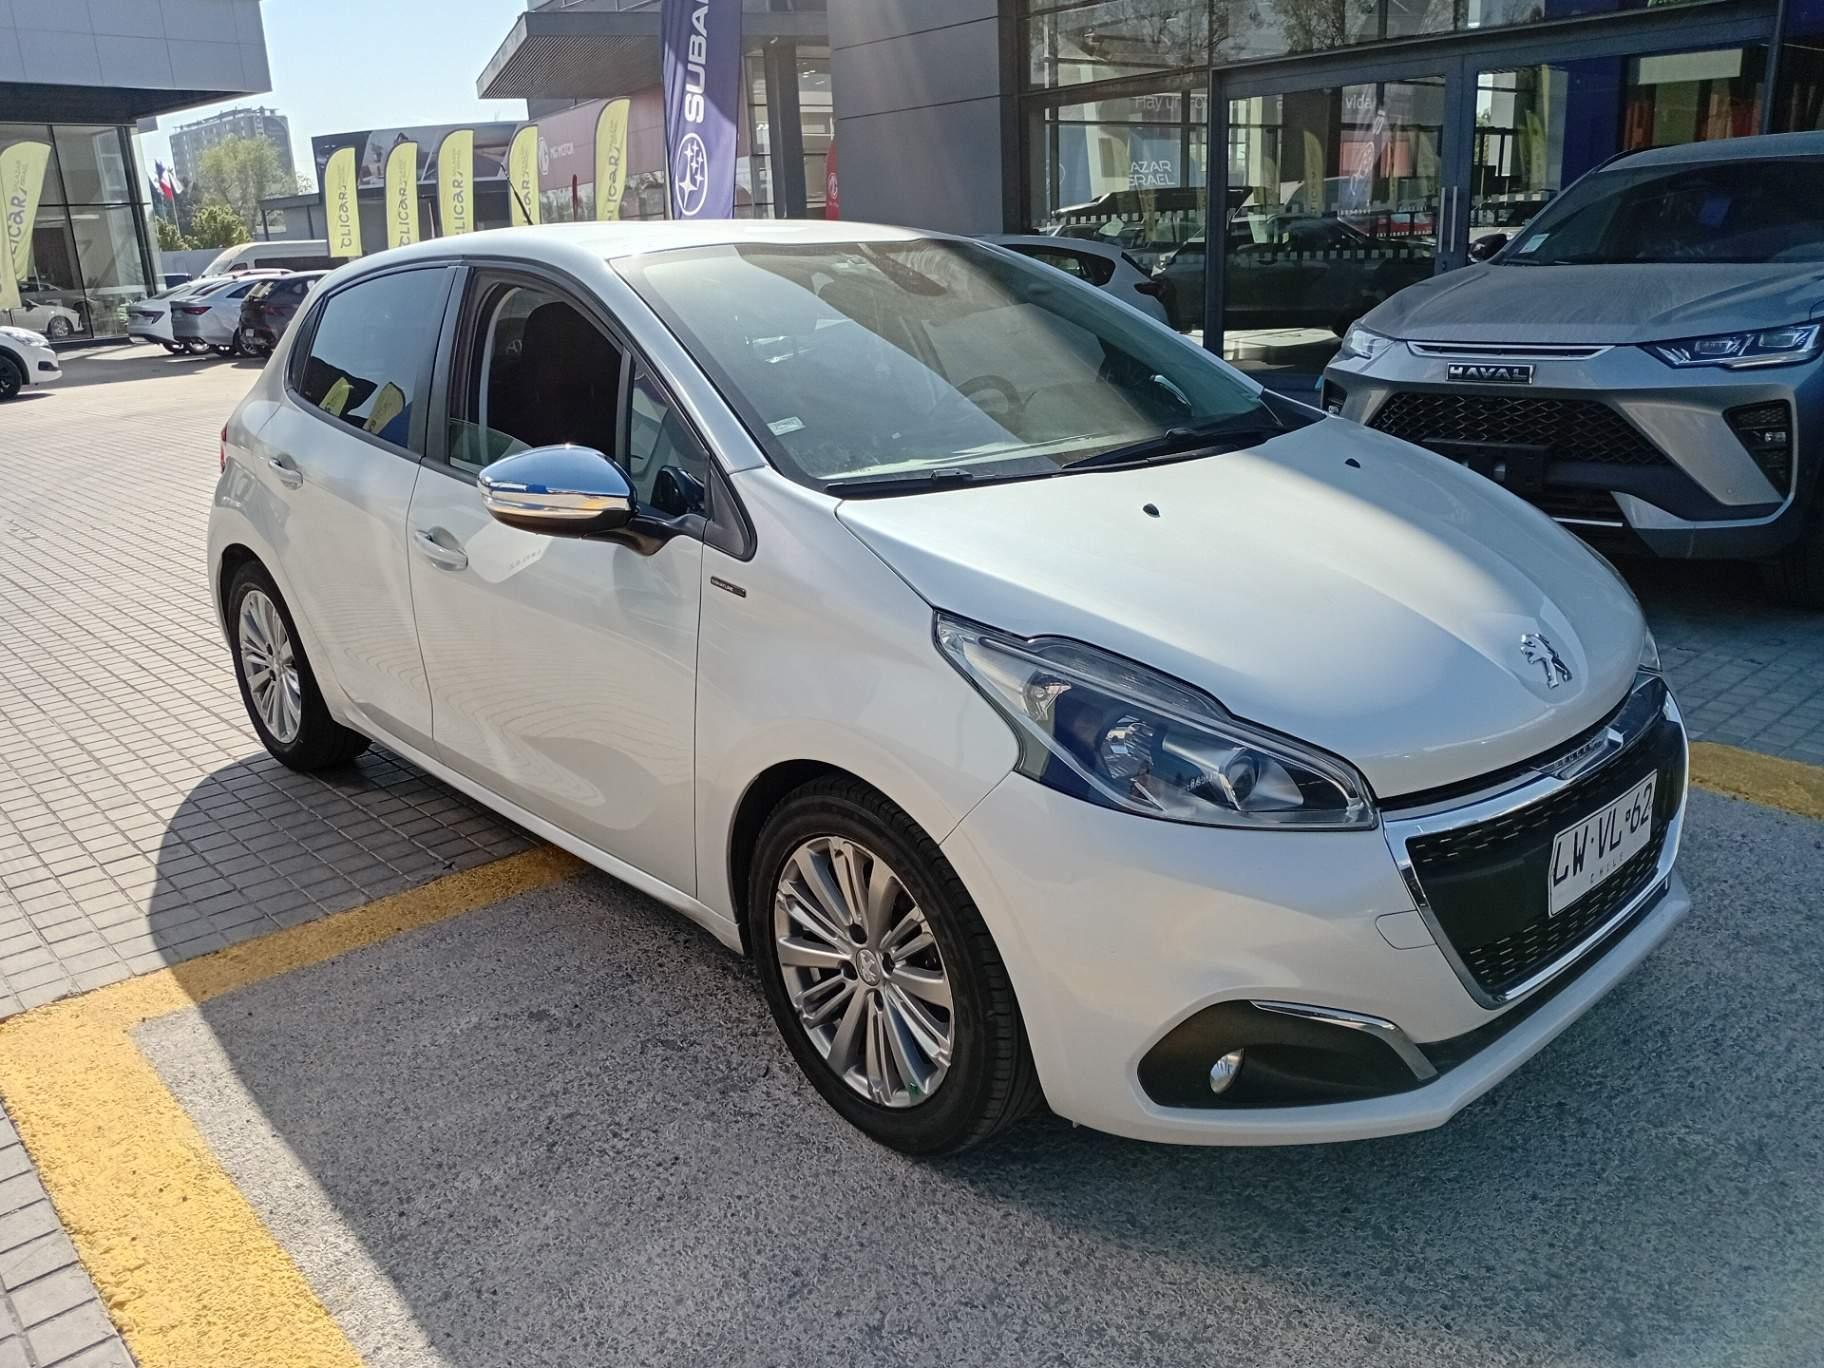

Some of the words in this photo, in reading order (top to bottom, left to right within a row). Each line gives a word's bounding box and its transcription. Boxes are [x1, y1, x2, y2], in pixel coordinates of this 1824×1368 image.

[684, 0, 710, 124] SUBA
[1130, 160, 1172, 173] AZAR
[1449, 366, 1528, 380] HAVAL
